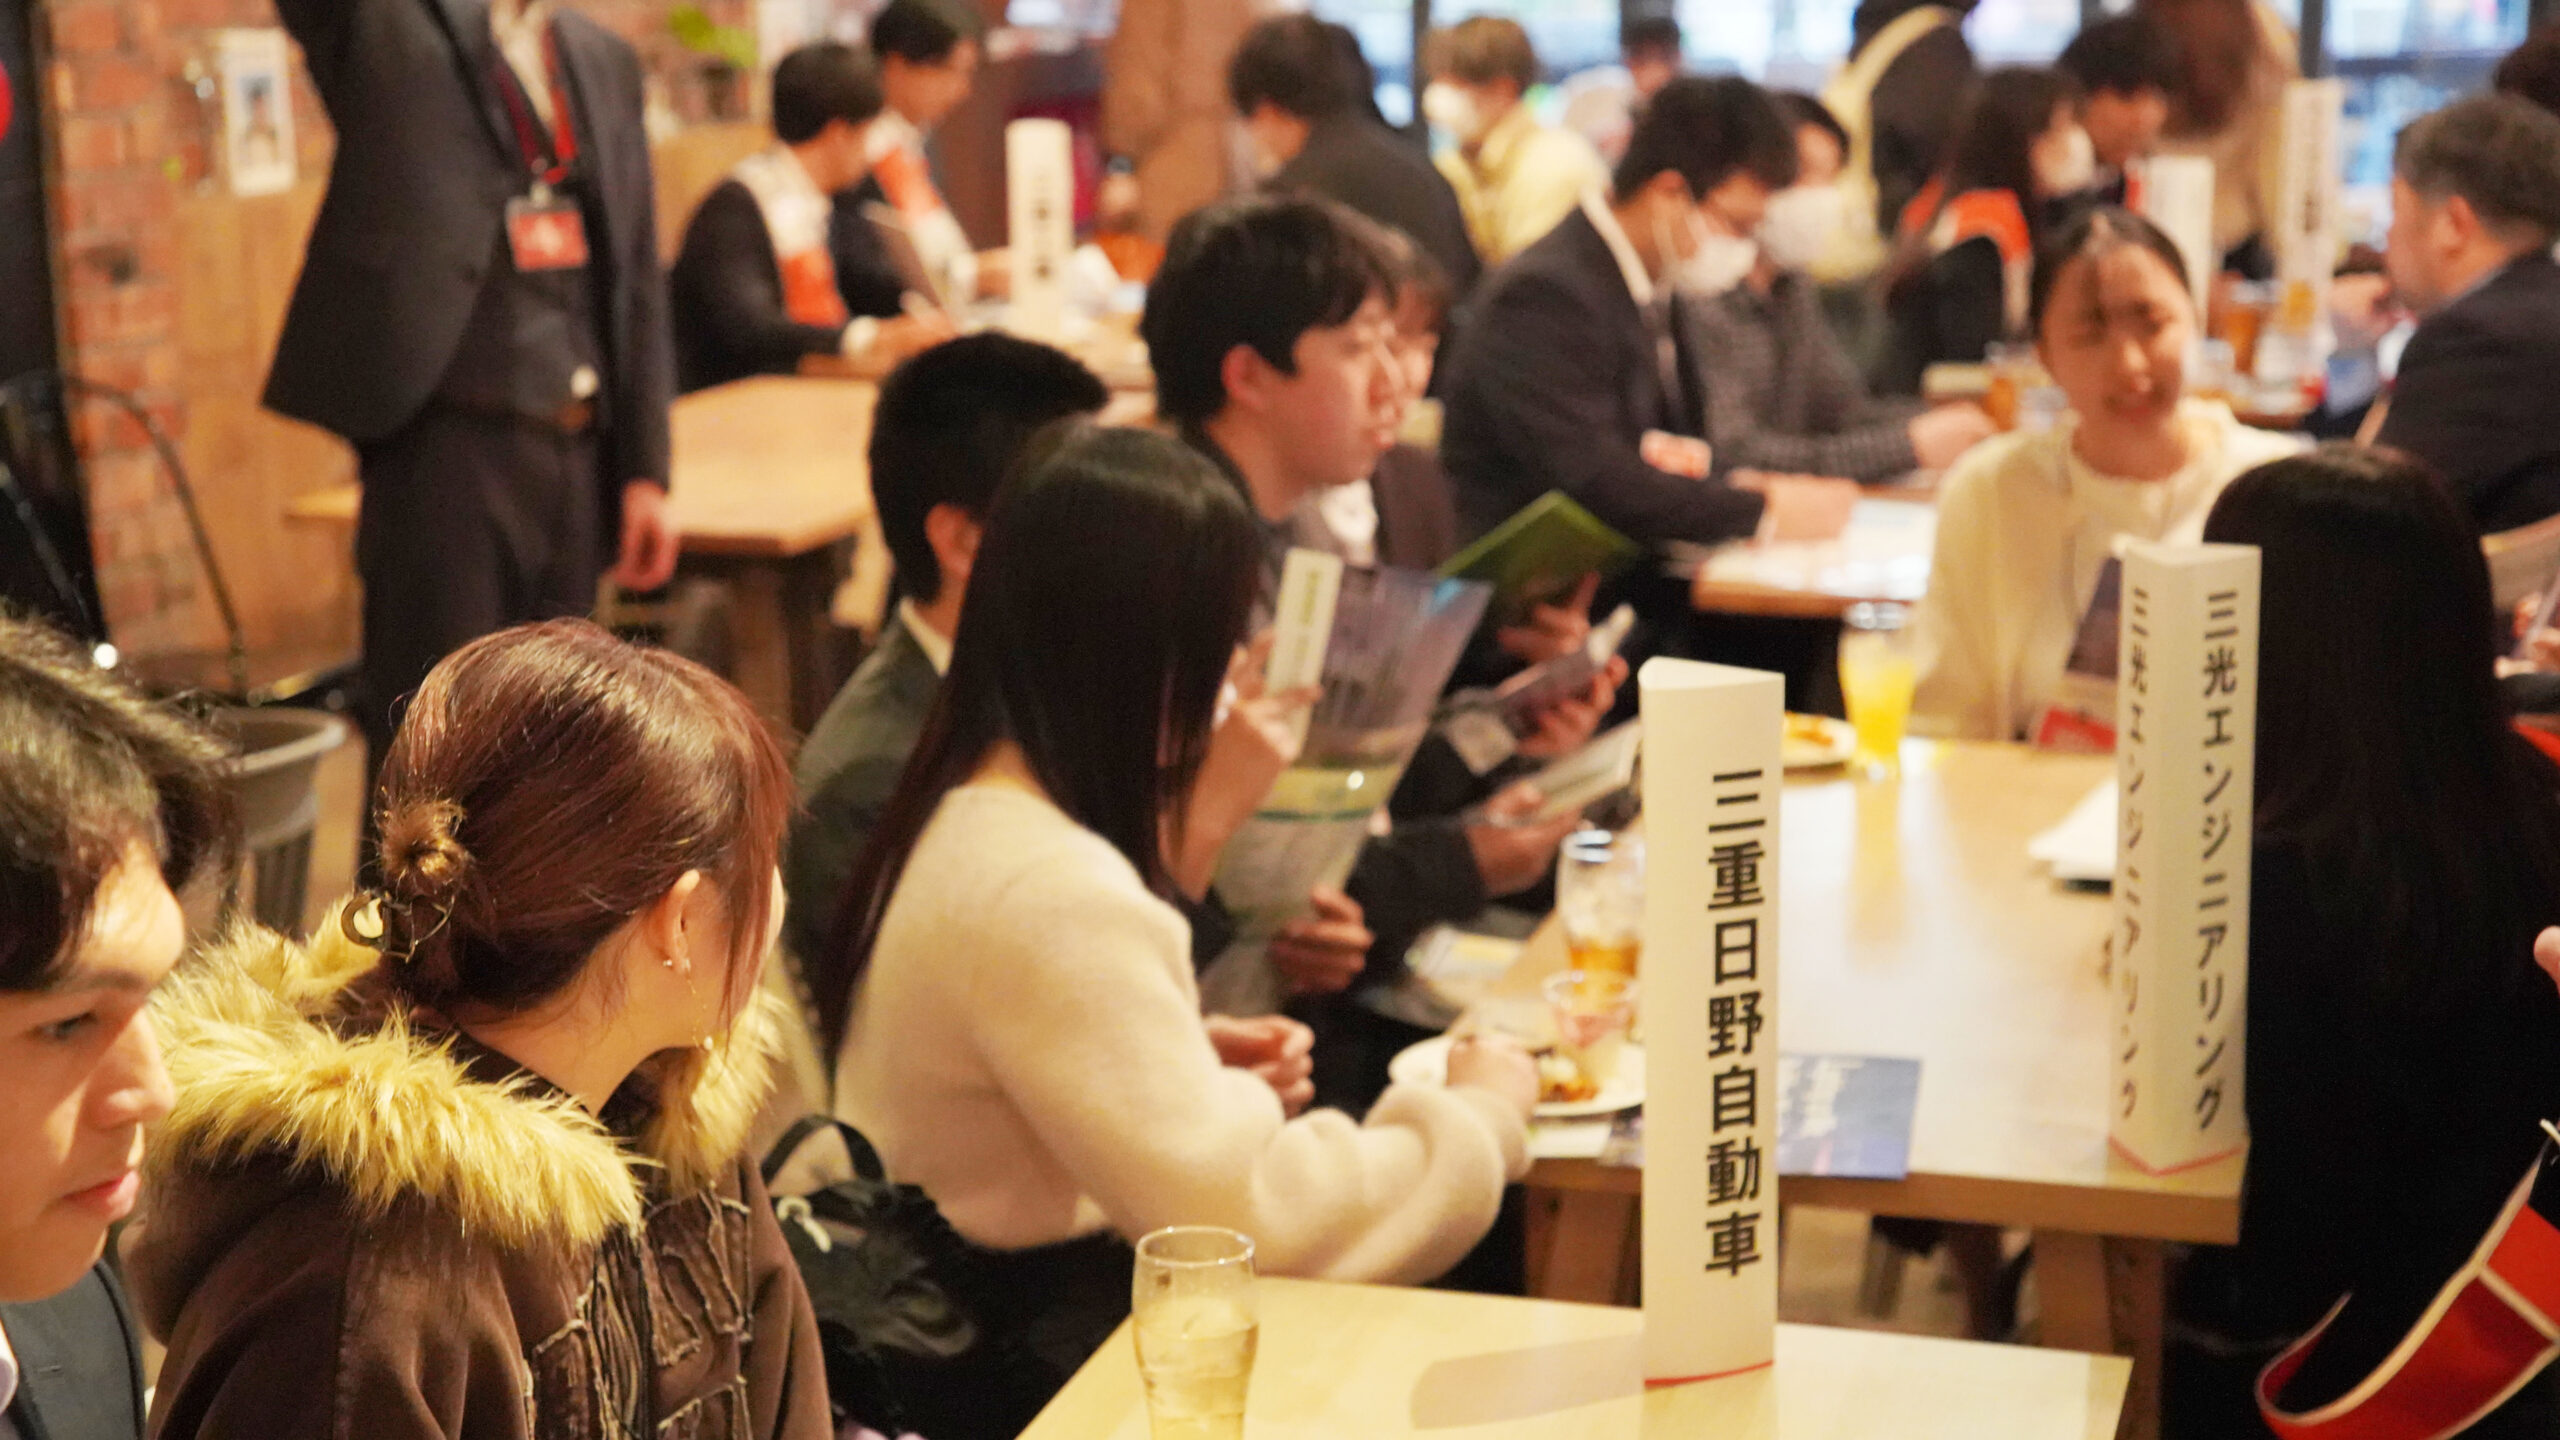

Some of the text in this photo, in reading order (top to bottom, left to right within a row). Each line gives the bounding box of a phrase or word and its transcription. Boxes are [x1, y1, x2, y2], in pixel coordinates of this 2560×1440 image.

[1704, 768, 1766, 1277] 三重日野自動車
[2195, 590, 2238, 1131] 三光エンジニアリング
